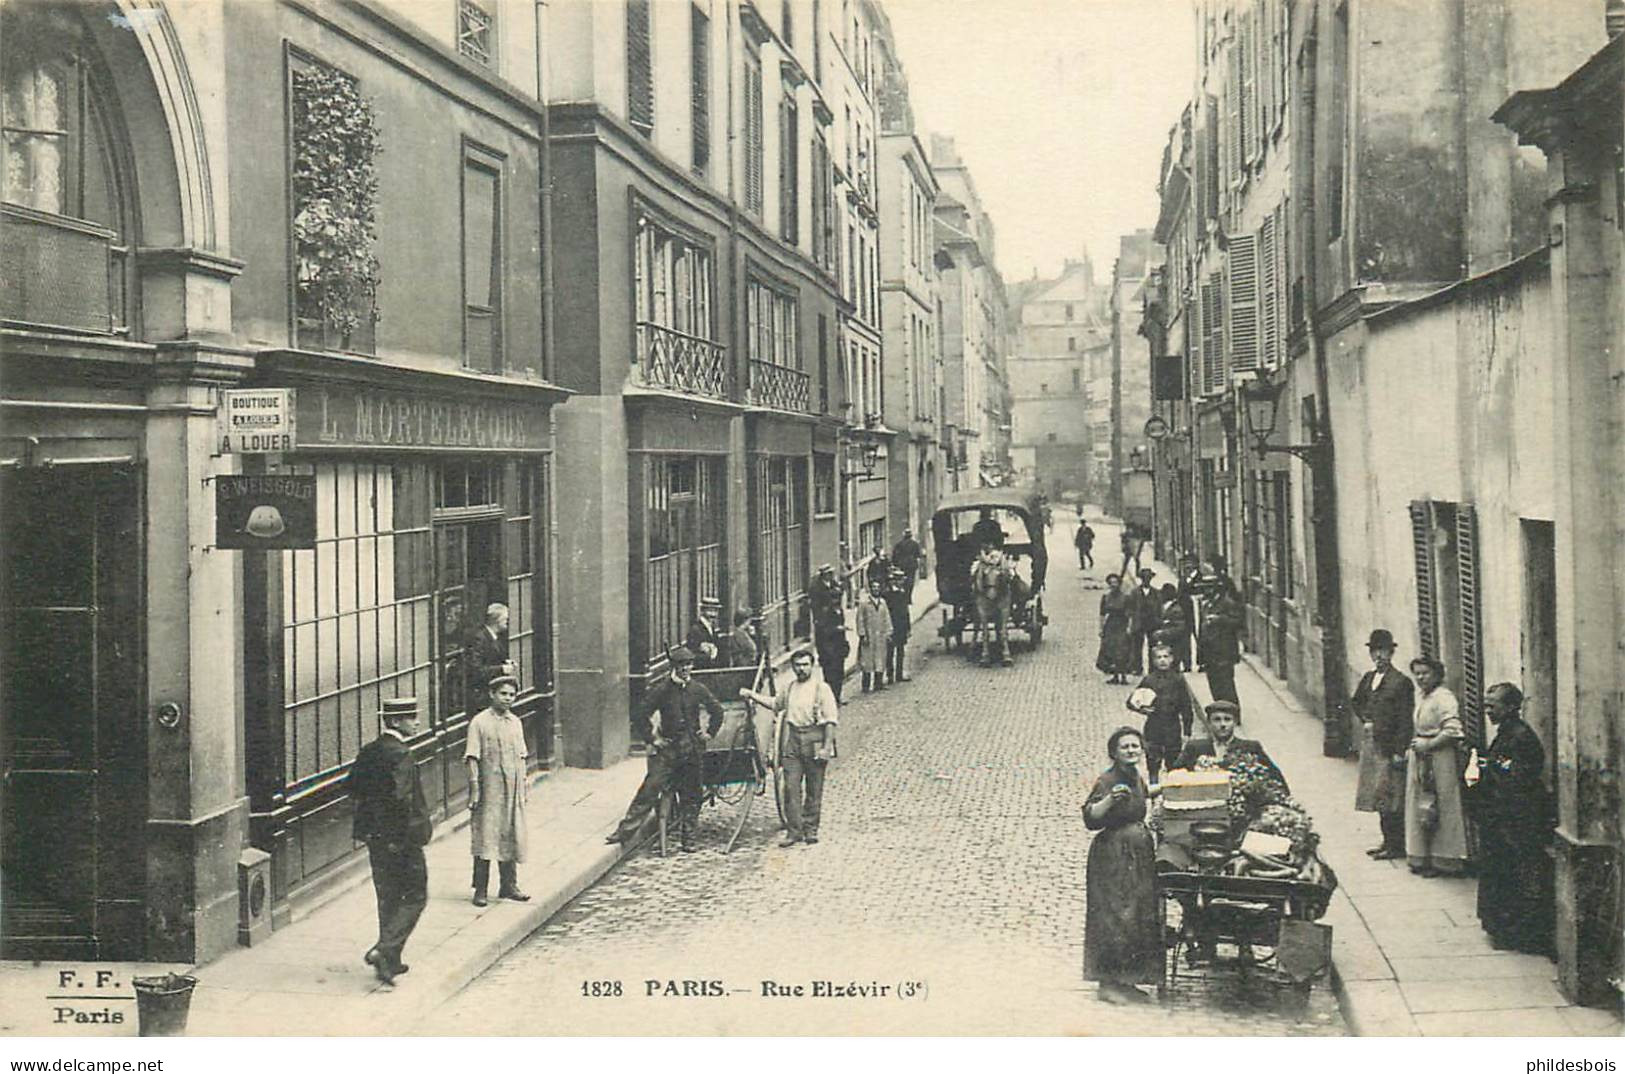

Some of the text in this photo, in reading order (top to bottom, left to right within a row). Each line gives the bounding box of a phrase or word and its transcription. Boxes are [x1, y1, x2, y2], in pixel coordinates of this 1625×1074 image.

[232, 397, 279, 408] BOUTIQUE
[222, 435, 290, 451] A LOUER
